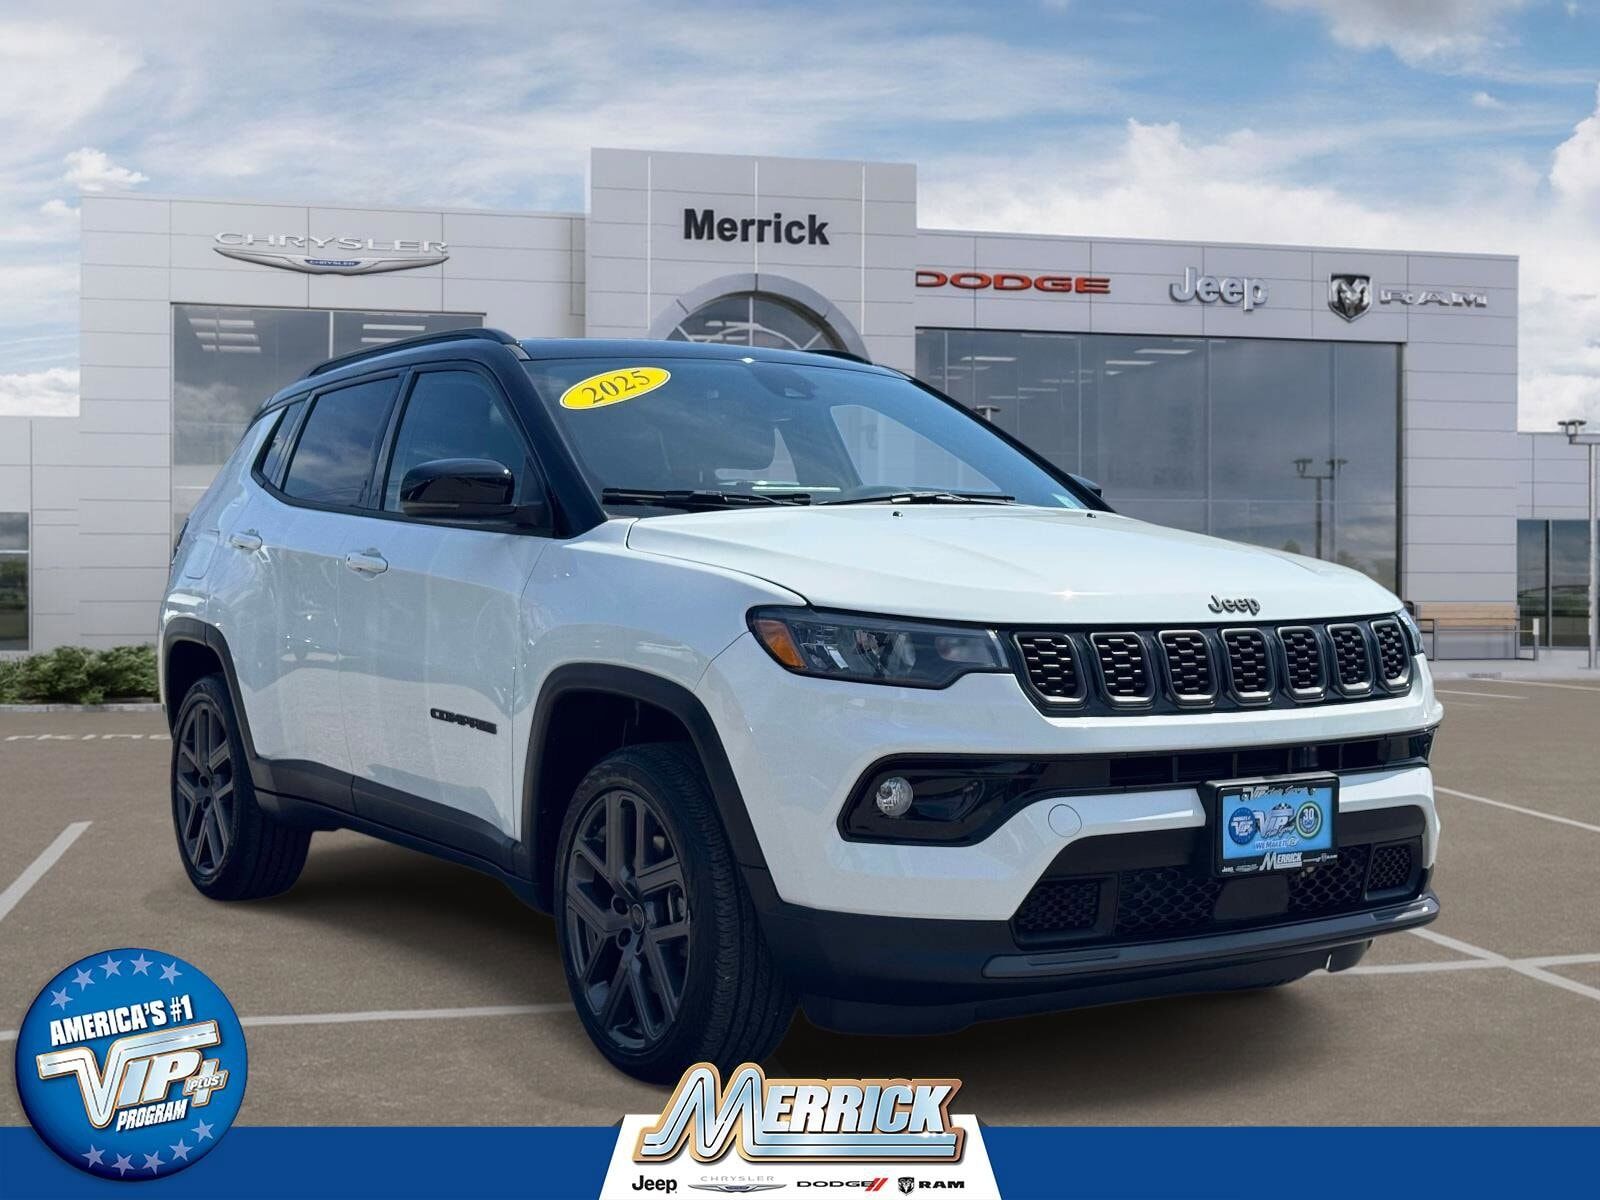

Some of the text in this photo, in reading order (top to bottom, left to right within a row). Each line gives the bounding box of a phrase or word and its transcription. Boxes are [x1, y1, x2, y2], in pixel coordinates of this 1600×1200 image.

[684, 208, 830, 246] Merrick
[213, 231, 449, 255] CHRYSLER
[915, 270, 1111, 294] DODGE
[1169, 266, 1268, 311] Jeep
[1379, 287, 1488, 309] RAM
[582, 369, 651, 404] 2025
[1207, 594, 1261, 617] Jeep
[1303, 808, 1314, 820] 30
[1259, 851, 1302, 871] MERRICK
